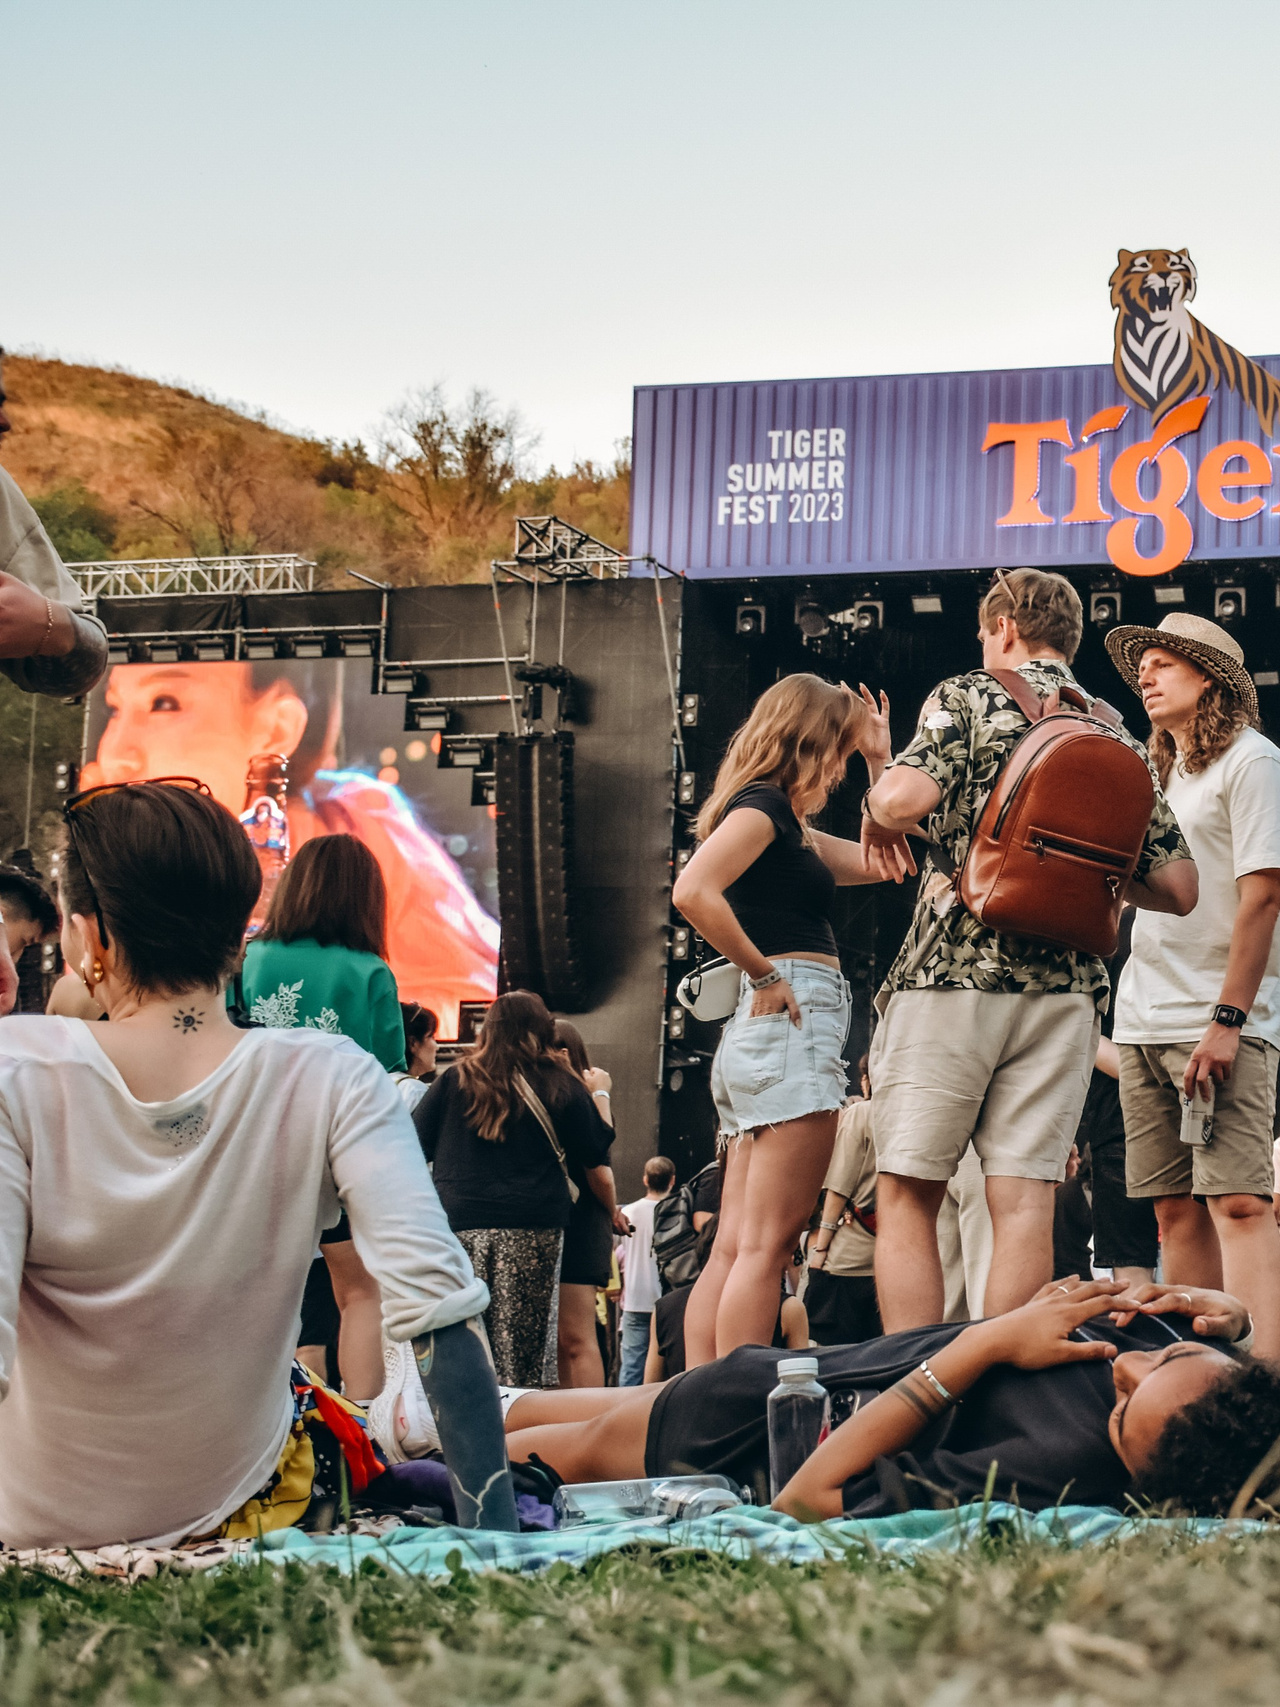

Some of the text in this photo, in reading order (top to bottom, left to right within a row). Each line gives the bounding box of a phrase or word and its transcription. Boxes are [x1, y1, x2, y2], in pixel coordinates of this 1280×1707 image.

[767, 428, 846, 460] TIGER
[727, 460, 845, 493] SUMMER
[717, 491, 844, 526] FEST 2023
